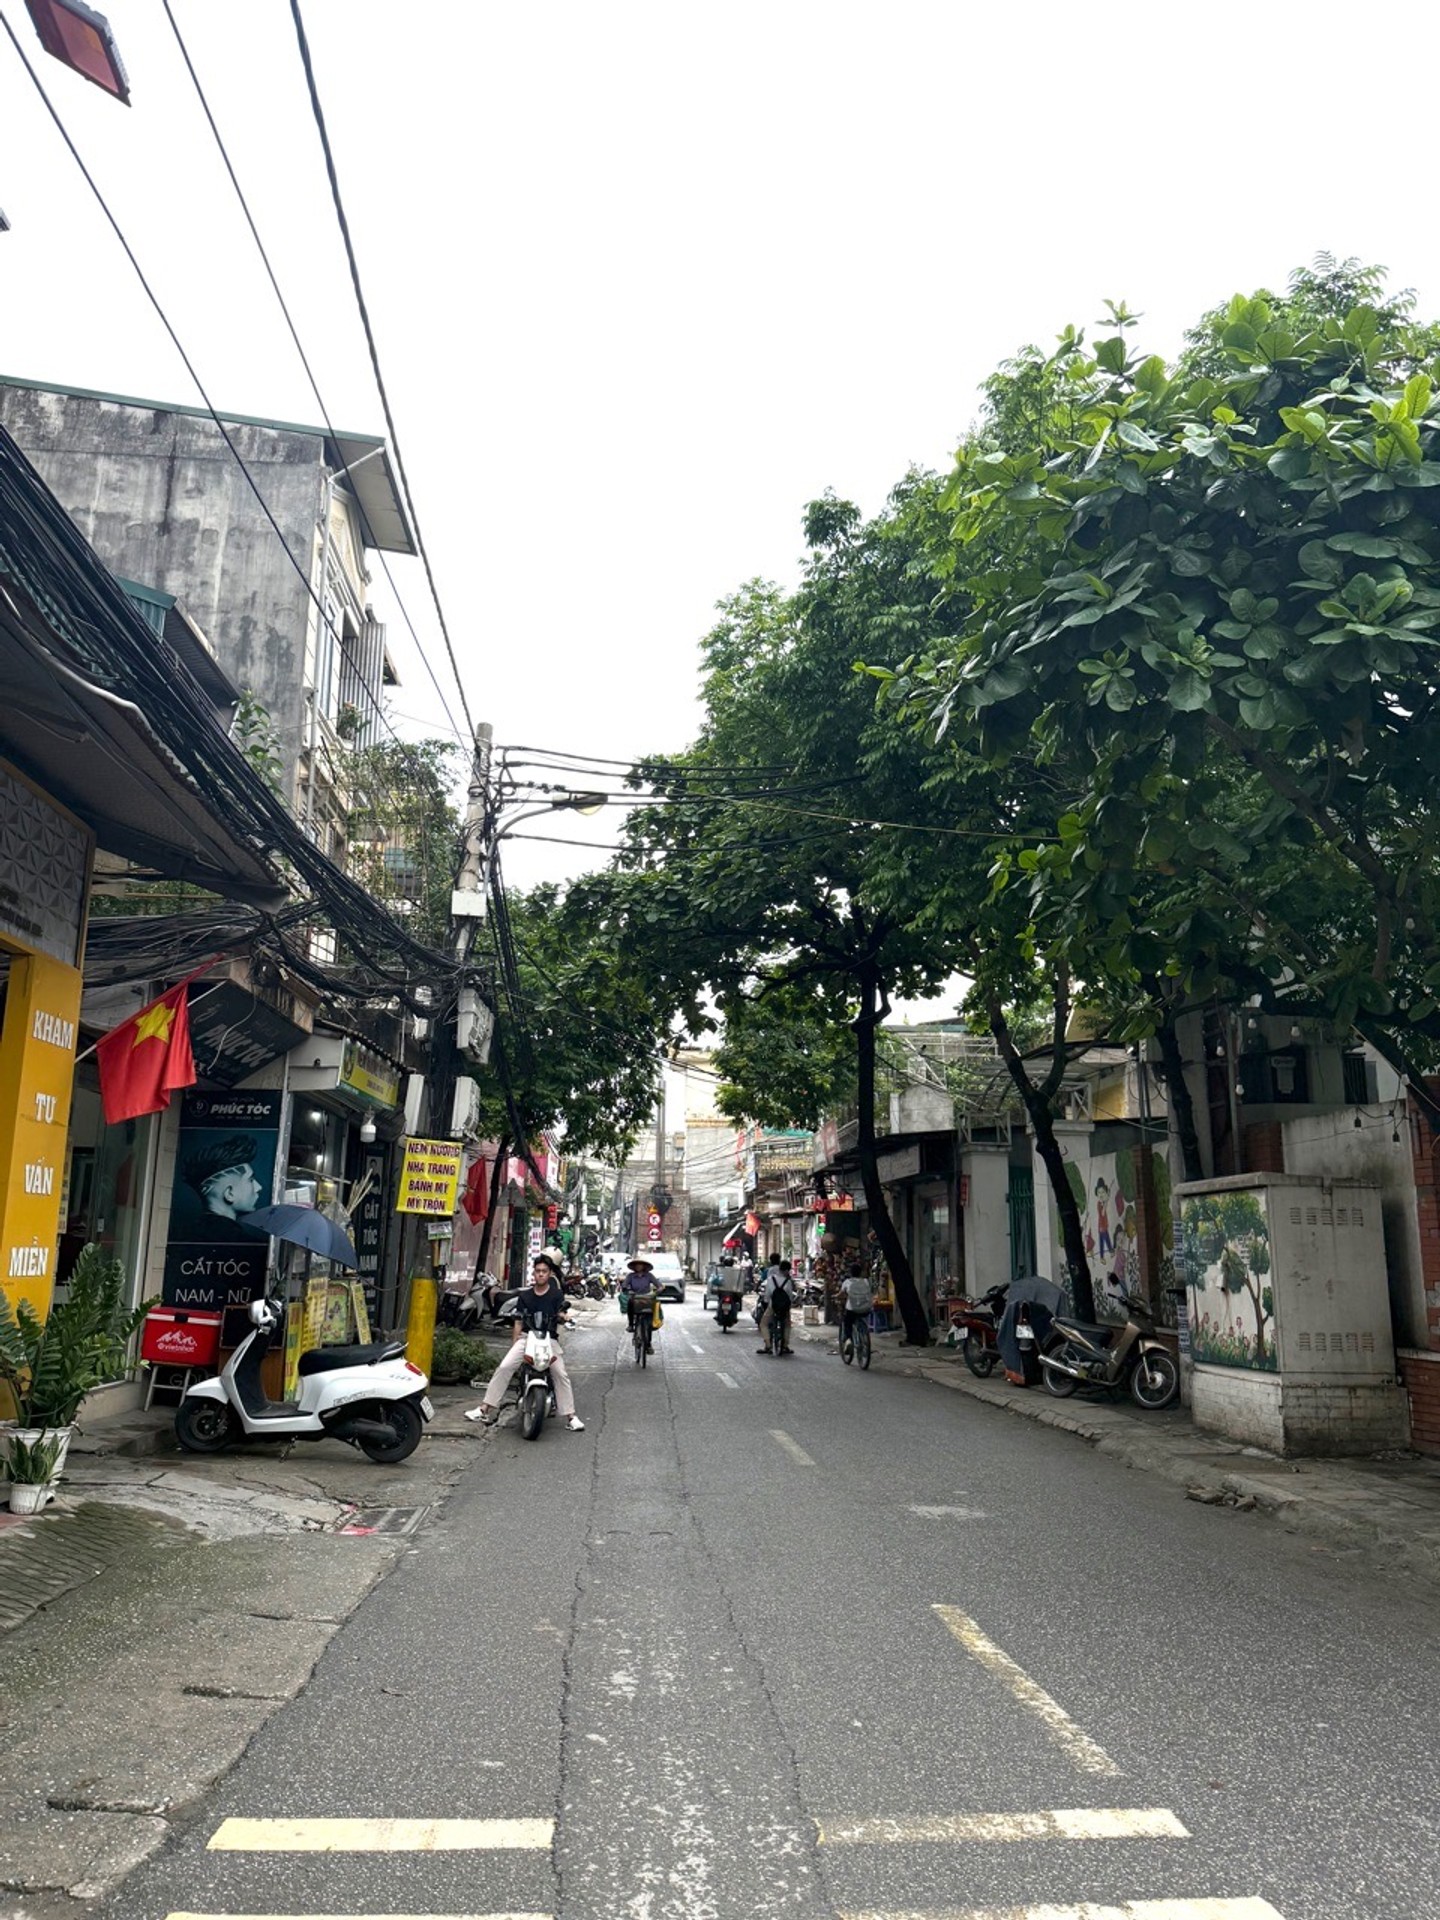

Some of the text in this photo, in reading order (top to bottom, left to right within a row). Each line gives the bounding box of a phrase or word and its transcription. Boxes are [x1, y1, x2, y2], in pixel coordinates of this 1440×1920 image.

[210, 1102, 272, 1115] PHÚC TÓC
[25, 1156, 54, 1195] VẤN
[407, 1160, 456, 1176] NHA TRANG
[180, 1256, 250, 1276] CẮT TÓC
[175, 1288, 214, 1303] NAM
[227, 1287, 252, 1304] NỮ
